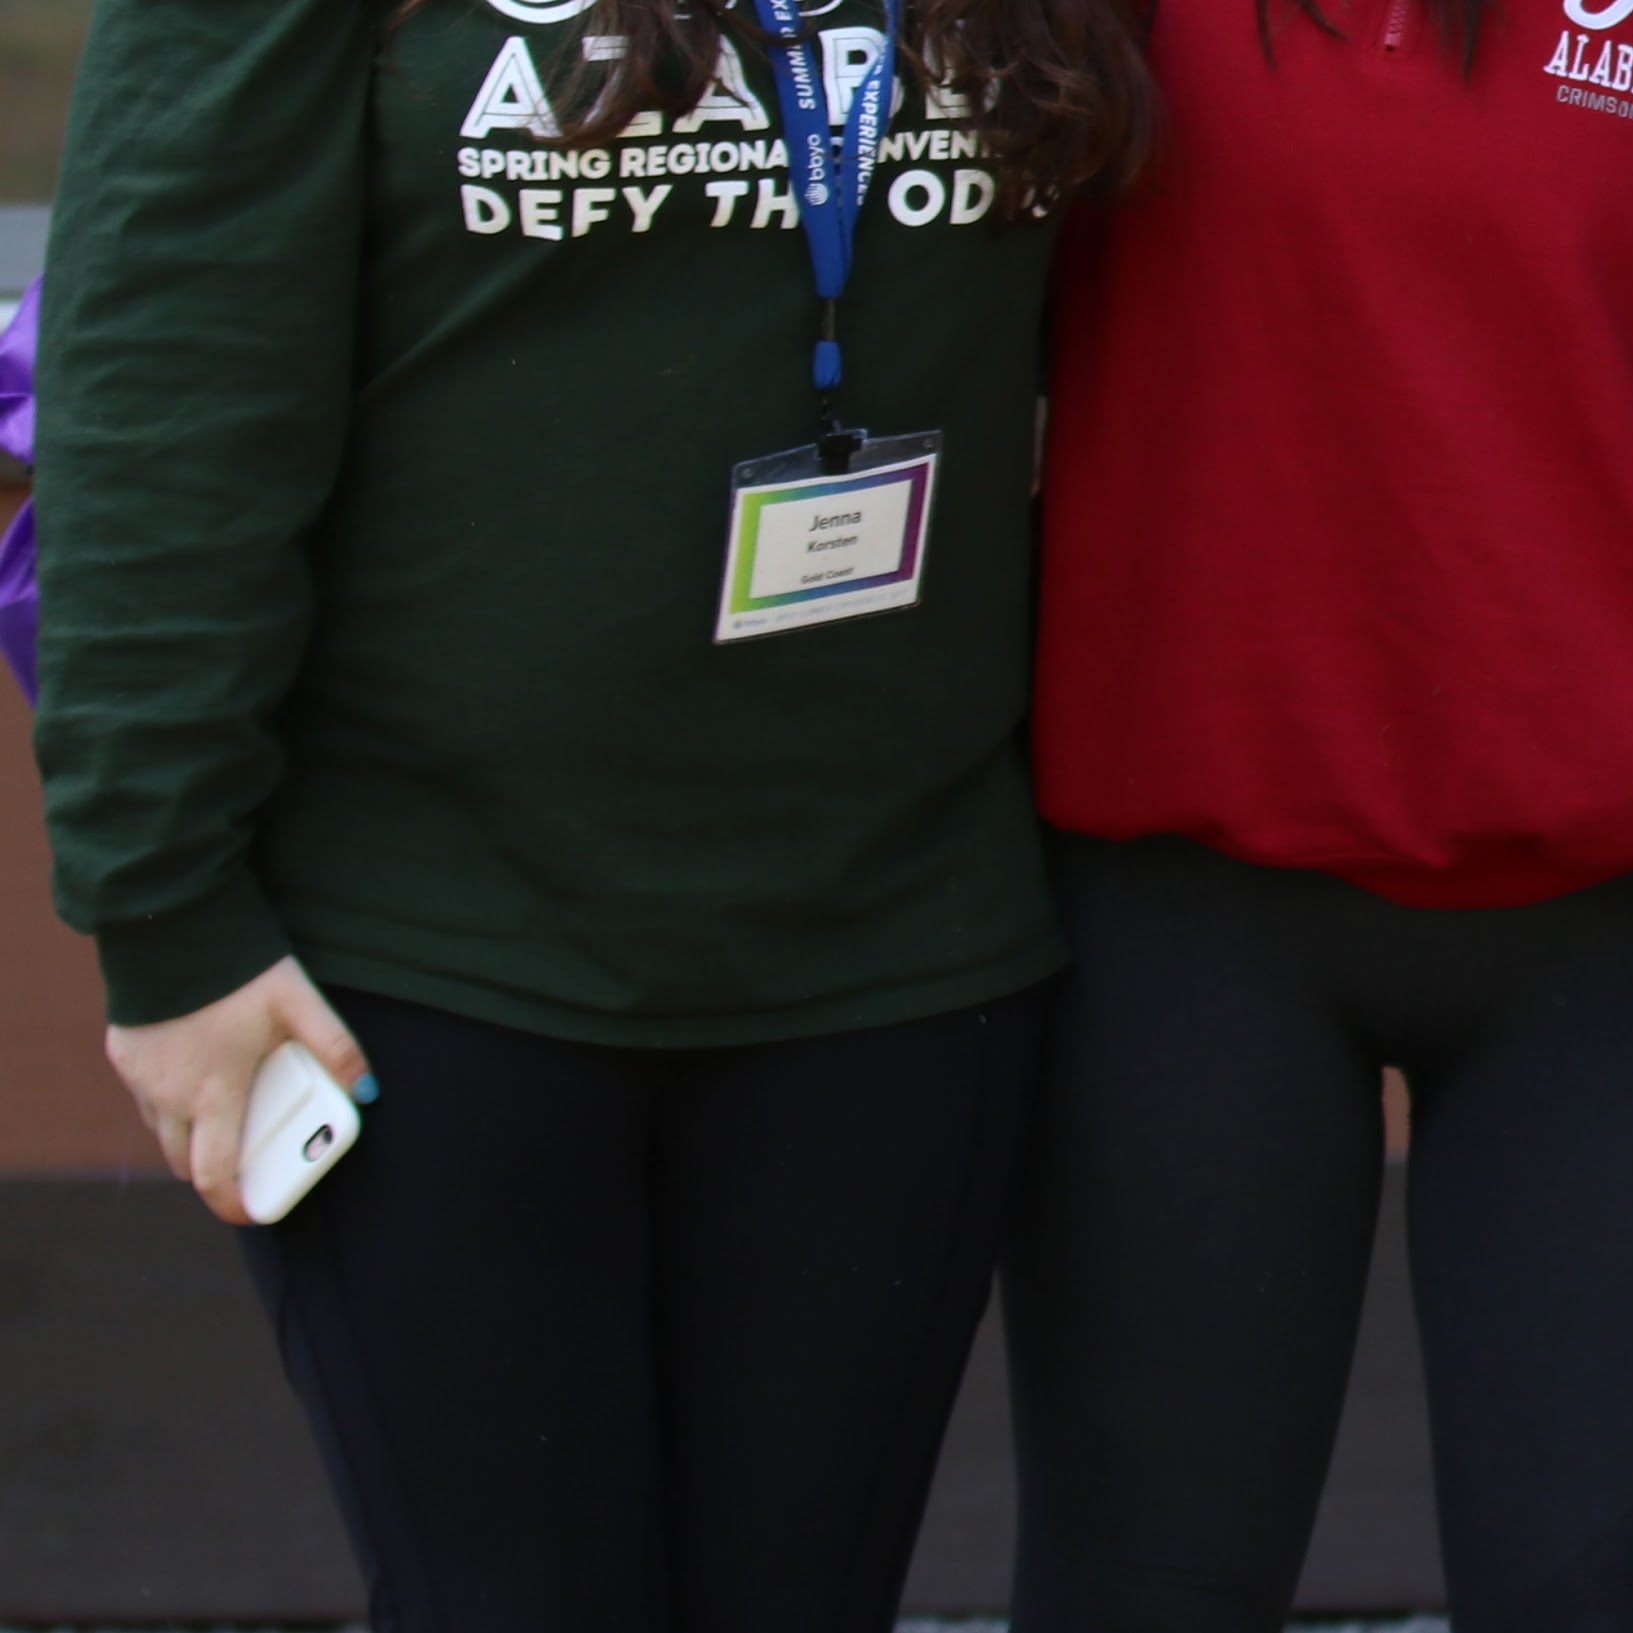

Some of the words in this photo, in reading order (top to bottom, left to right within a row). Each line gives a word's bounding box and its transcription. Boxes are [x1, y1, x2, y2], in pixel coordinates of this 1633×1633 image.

[780, 26, 816, 110] SUMMR
[457, 145, 611, 181] SPRING
[619, 138, 789, 179] REGIONA
[807, 134, 825, 181] bbyo
[460, 183, 673, 240] DEFY
[705, 178, 800, 230] TH
[808, 509, 863, 533] Jenna
